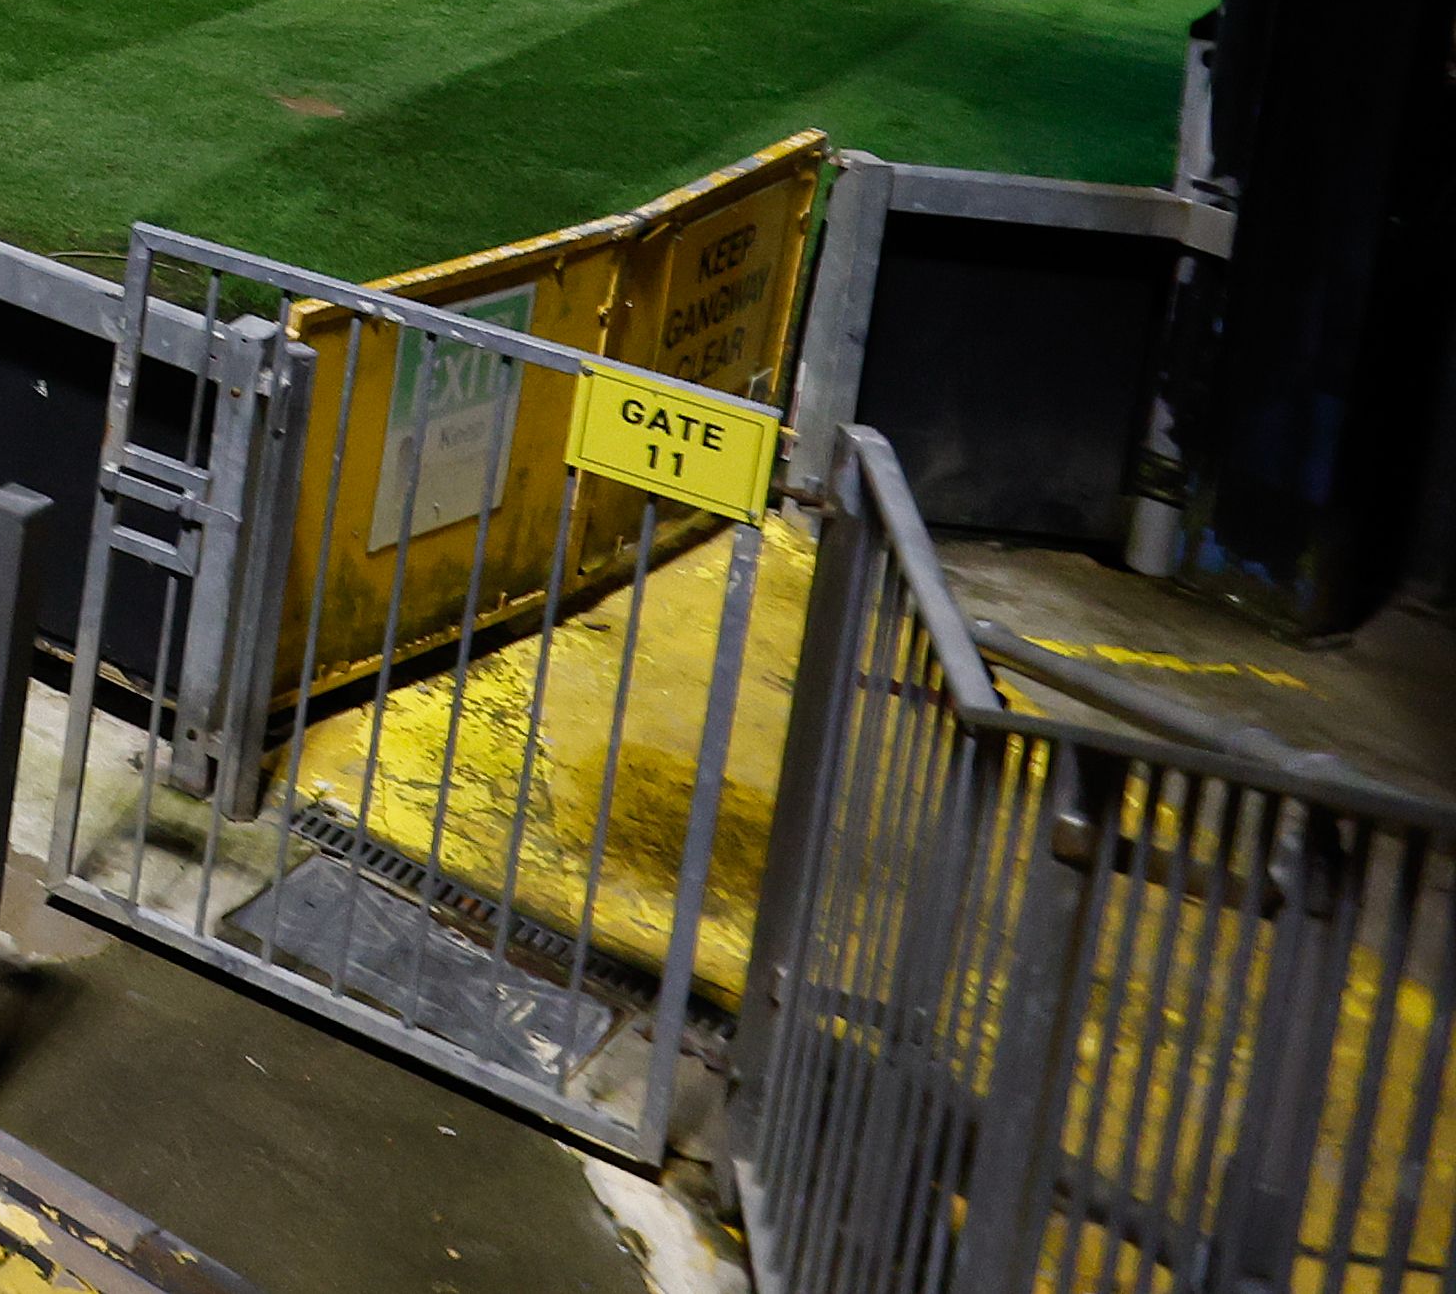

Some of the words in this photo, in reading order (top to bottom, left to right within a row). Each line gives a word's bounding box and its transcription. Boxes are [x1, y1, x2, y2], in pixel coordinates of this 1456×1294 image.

[699, 223, 756, 283] KEEP
[663, 261, 773, 349] GANGWAY
[682, 326, 746, 380] CLEAR
[621, 399, 725, 452] GATE
[646, 443, 685, 478] 11
